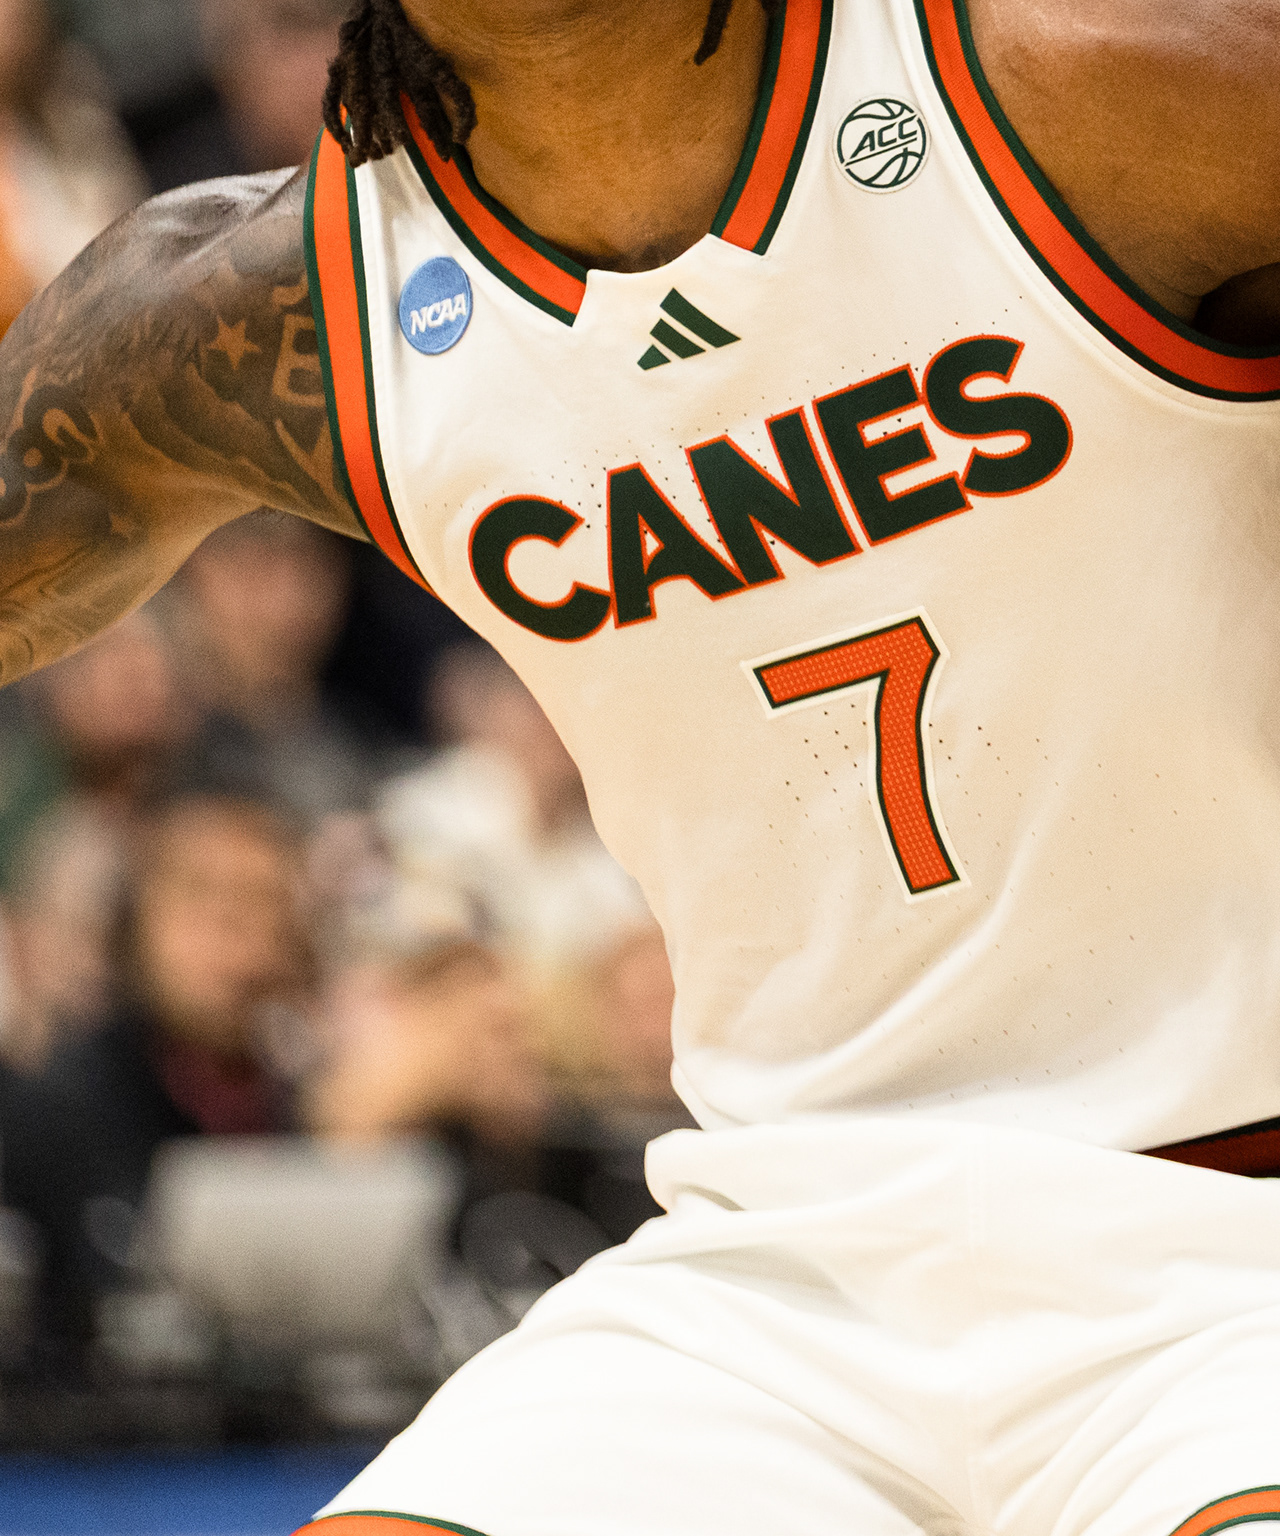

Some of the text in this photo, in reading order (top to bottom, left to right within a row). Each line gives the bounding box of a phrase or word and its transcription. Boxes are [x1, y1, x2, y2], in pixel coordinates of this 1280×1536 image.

[850, 114, 917, 159] ACC
[409, 293, 467, 336] NCAA
[467, 334, 1074, 642] CANES
[749, 612, 962, 896] 7
